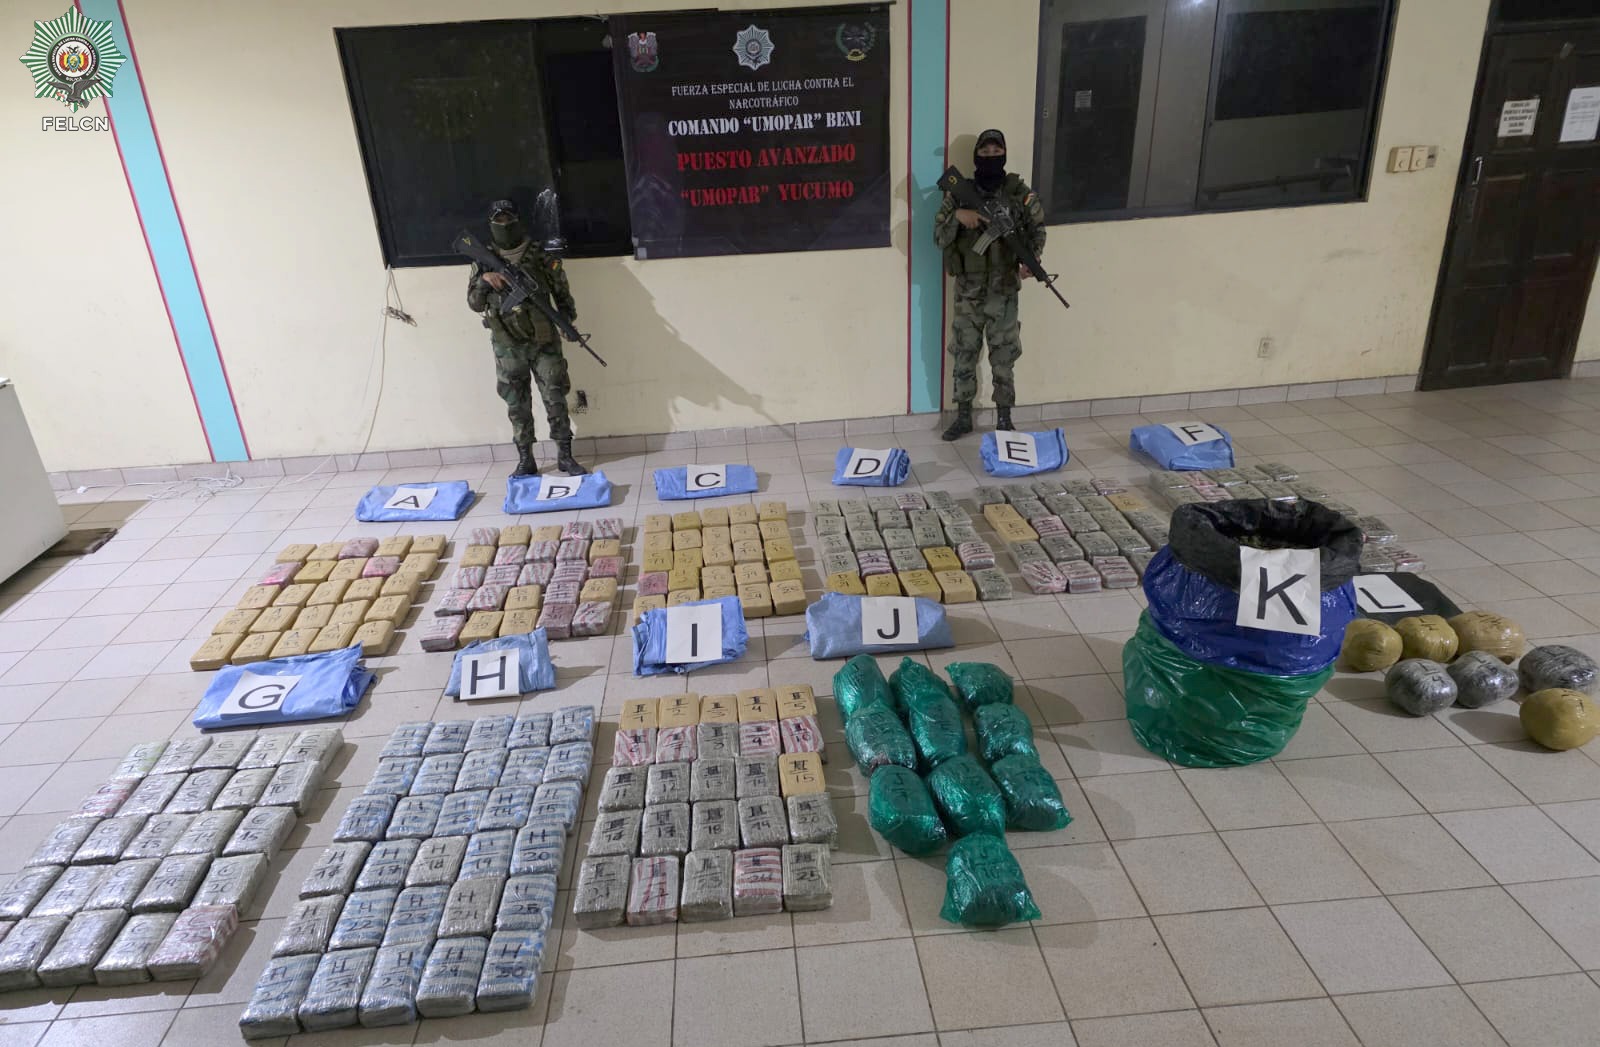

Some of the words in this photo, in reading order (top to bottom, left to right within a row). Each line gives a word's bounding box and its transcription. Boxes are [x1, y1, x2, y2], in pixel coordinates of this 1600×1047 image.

[672, 84, 709, 96] FUERZA
[711, 83, 756, 95] ESPECIAL
[757, 82, 770, 92] DE
[772, 80, 802, 92] LUCHA
[804, 78, 840, 89] CONTRA
[842, 78, 854, 88] EL
[729, 95, 799, 109] NARCOTRÁFICO
[668, 118, 740, 136] COMANDO
[826, 111, 861, 128] BENI
[676, 149, 752, 171] PUESTO
[758, 144, 856, 166] AVANZADO
[777, 181, 854, 202] YUCUMO
[1180, 425, 1204, 441] F
[1005, 440, 1030, 462] E
[853, 458, 881, 475] D
[695, 472, 720, 487] C
[392, 495, 420, 508] A
[1256, 566, 1308, 626] K
[1359, 587, 1405, 609] L
[877, 608, 900, 639] J
[691, 623, 697, 657] I
[470, 656, 506, 695] H
[238, 684, 285, 710] G
[402, 729, 416, 737] H
[752, 737, 761, 746] 9
[559, 750, 570, 759] H
[391, 763, 404, 771] H
[436, 761, 448, 770] H
[795, 775, 814, 783] 15
[497, 793, 513, 804] H
[454, 801, 466, 810] H
[529, 829, 546, 843] H
[432, 844, 446, 854] H
[478, 839, 494, 850] H
[328, 851, 346, 863] H
[382, 848, 399, 859] H
[524, 851, 551, 862] 20
[475, 858, 492, 869] 19
[796, 870, 821, 882] 25
[457, 890, 474, 902] H
[515, 885, 528, 894] H
[359, 902, 372, 912] H
[410, 894, 423, 907] H
[301, 905, 318, 919] H
[347, 919, 372, 932] 22
[398, 913, 426, 925] 23
[446, 947, 463, 960] H
[501, 943, 522, 958] H
[398, 951, 413, 967] H
[332, 958, 347, 974] H
